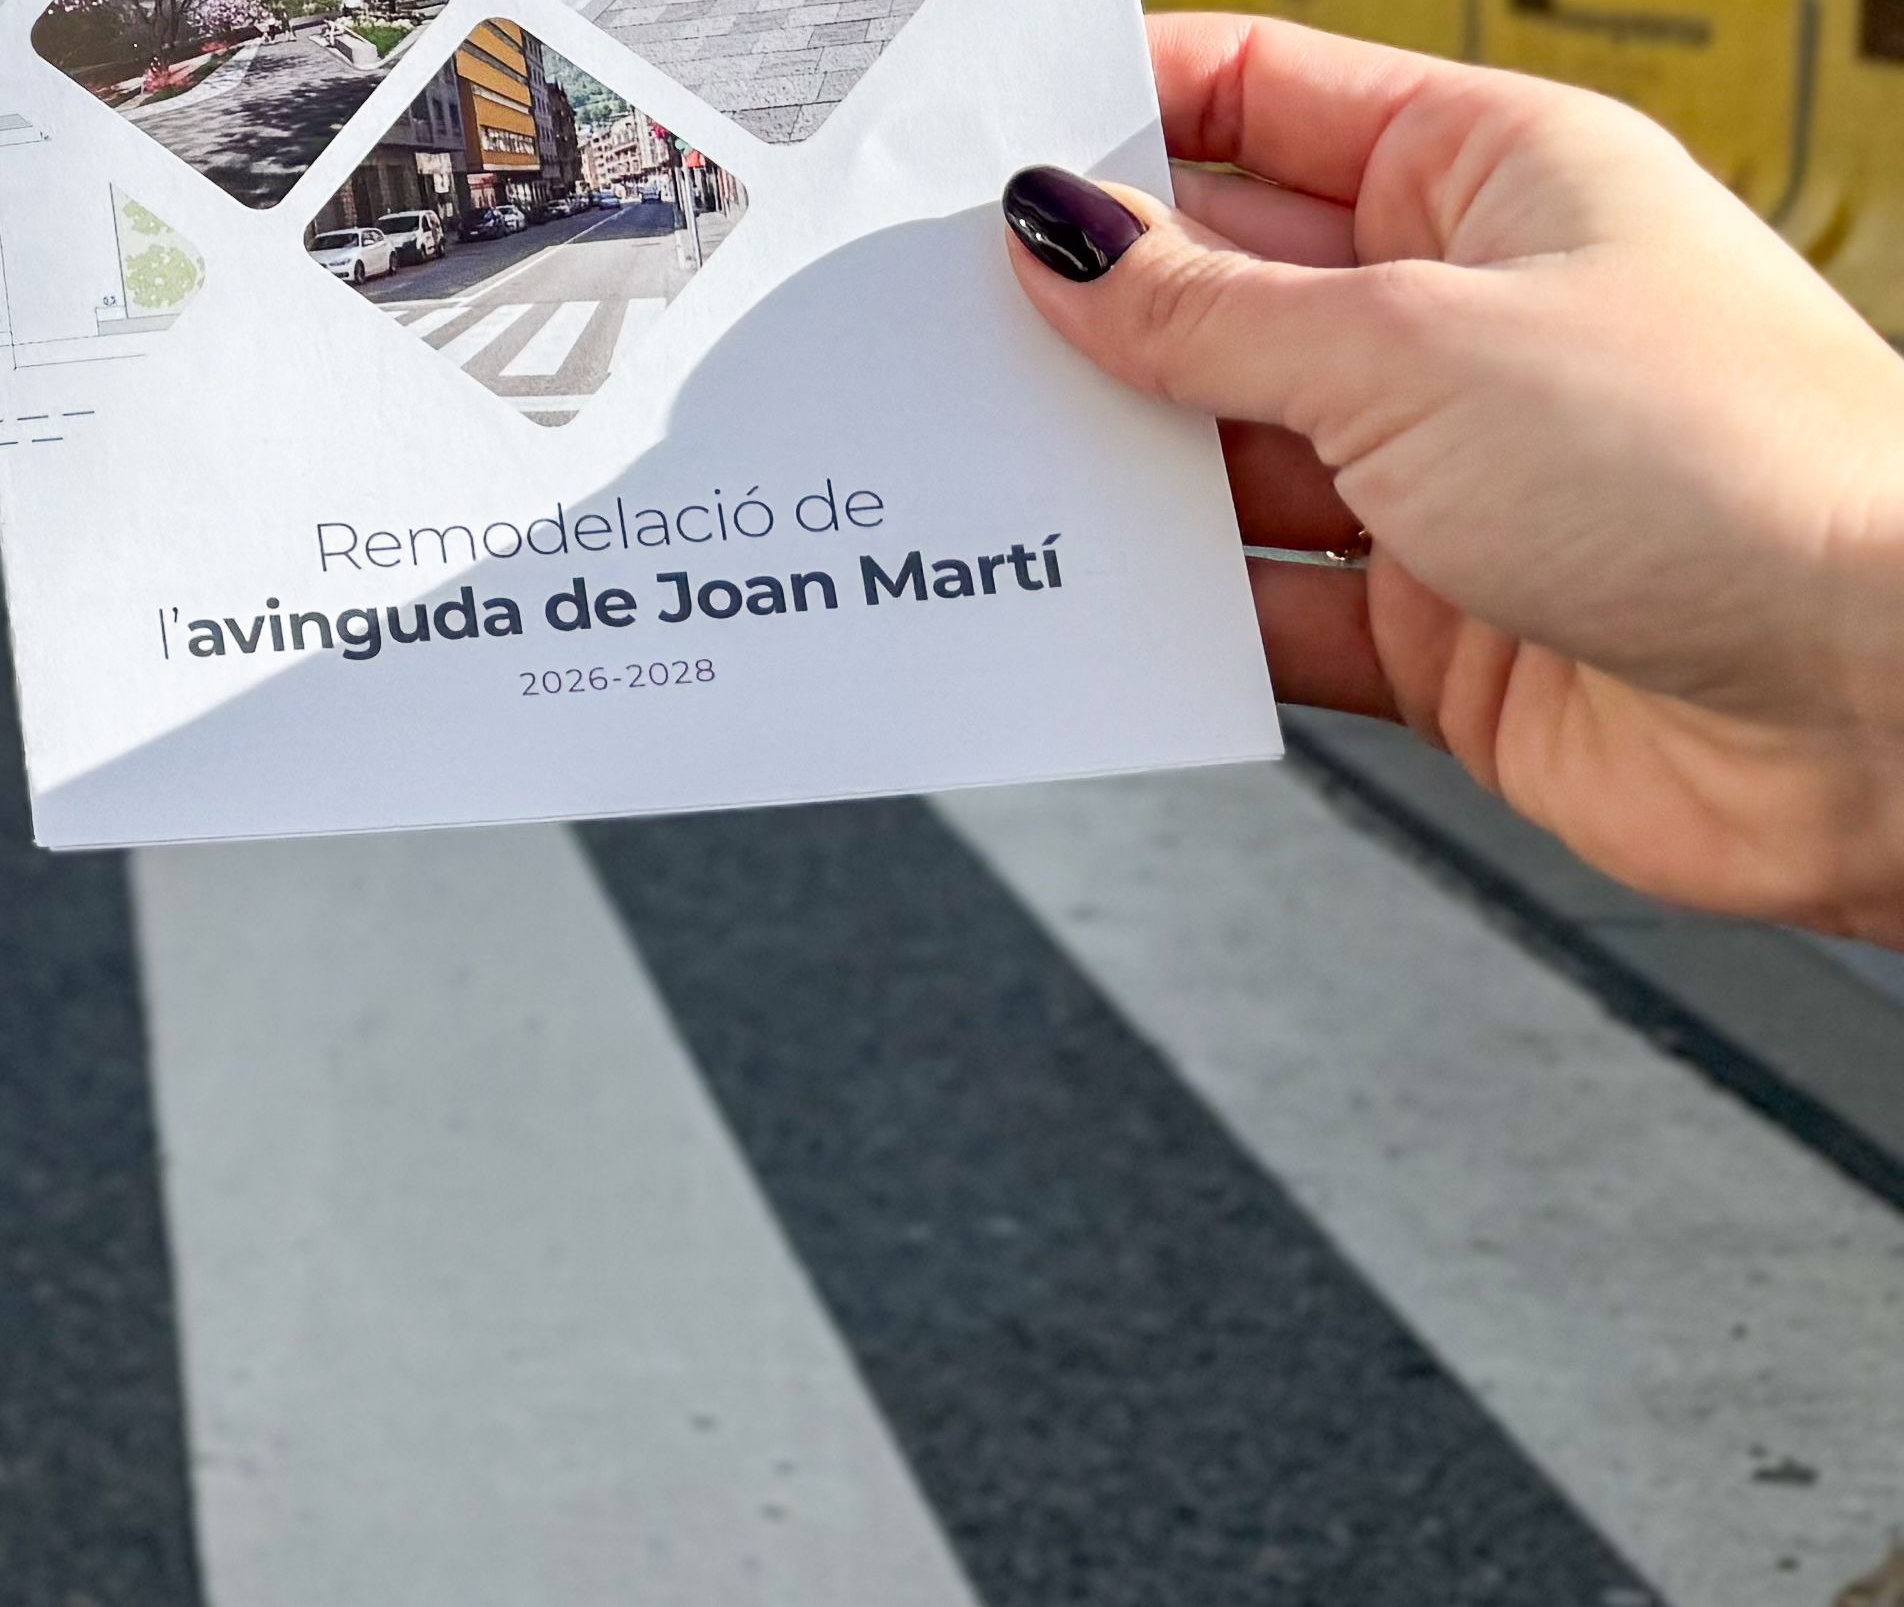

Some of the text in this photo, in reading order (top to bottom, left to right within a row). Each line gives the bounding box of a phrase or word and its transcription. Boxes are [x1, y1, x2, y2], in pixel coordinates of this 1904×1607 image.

[316, 478, 884, 572] Remodelació de
[158, 532, 1062, 661] l'avinguda de Joan Martí
[519, 658, 716, 697] 2026-2028
